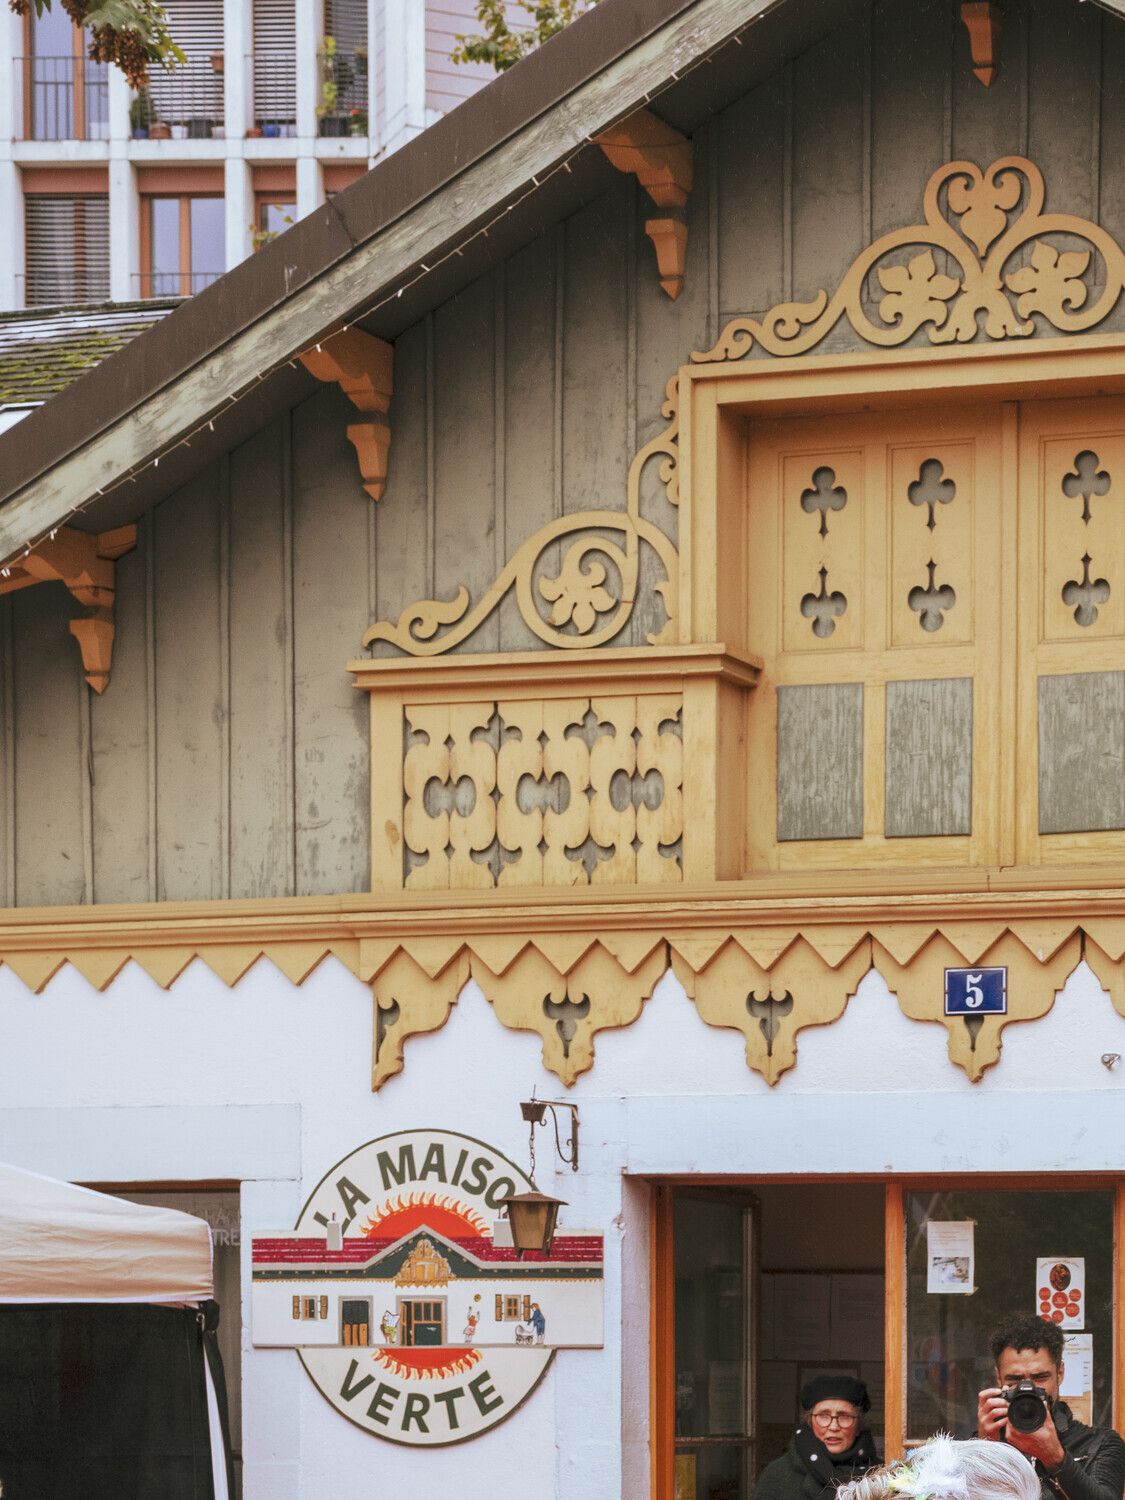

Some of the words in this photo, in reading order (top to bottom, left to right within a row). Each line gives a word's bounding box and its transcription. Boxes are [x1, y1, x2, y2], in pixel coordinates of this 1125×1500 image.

[965, 974, 984, 1008] 5
[313, 1176, 371, 1234] LA
[376, 1143, 517, 1211] MAISO
[339, 1359, 505, 1434] VERTE
